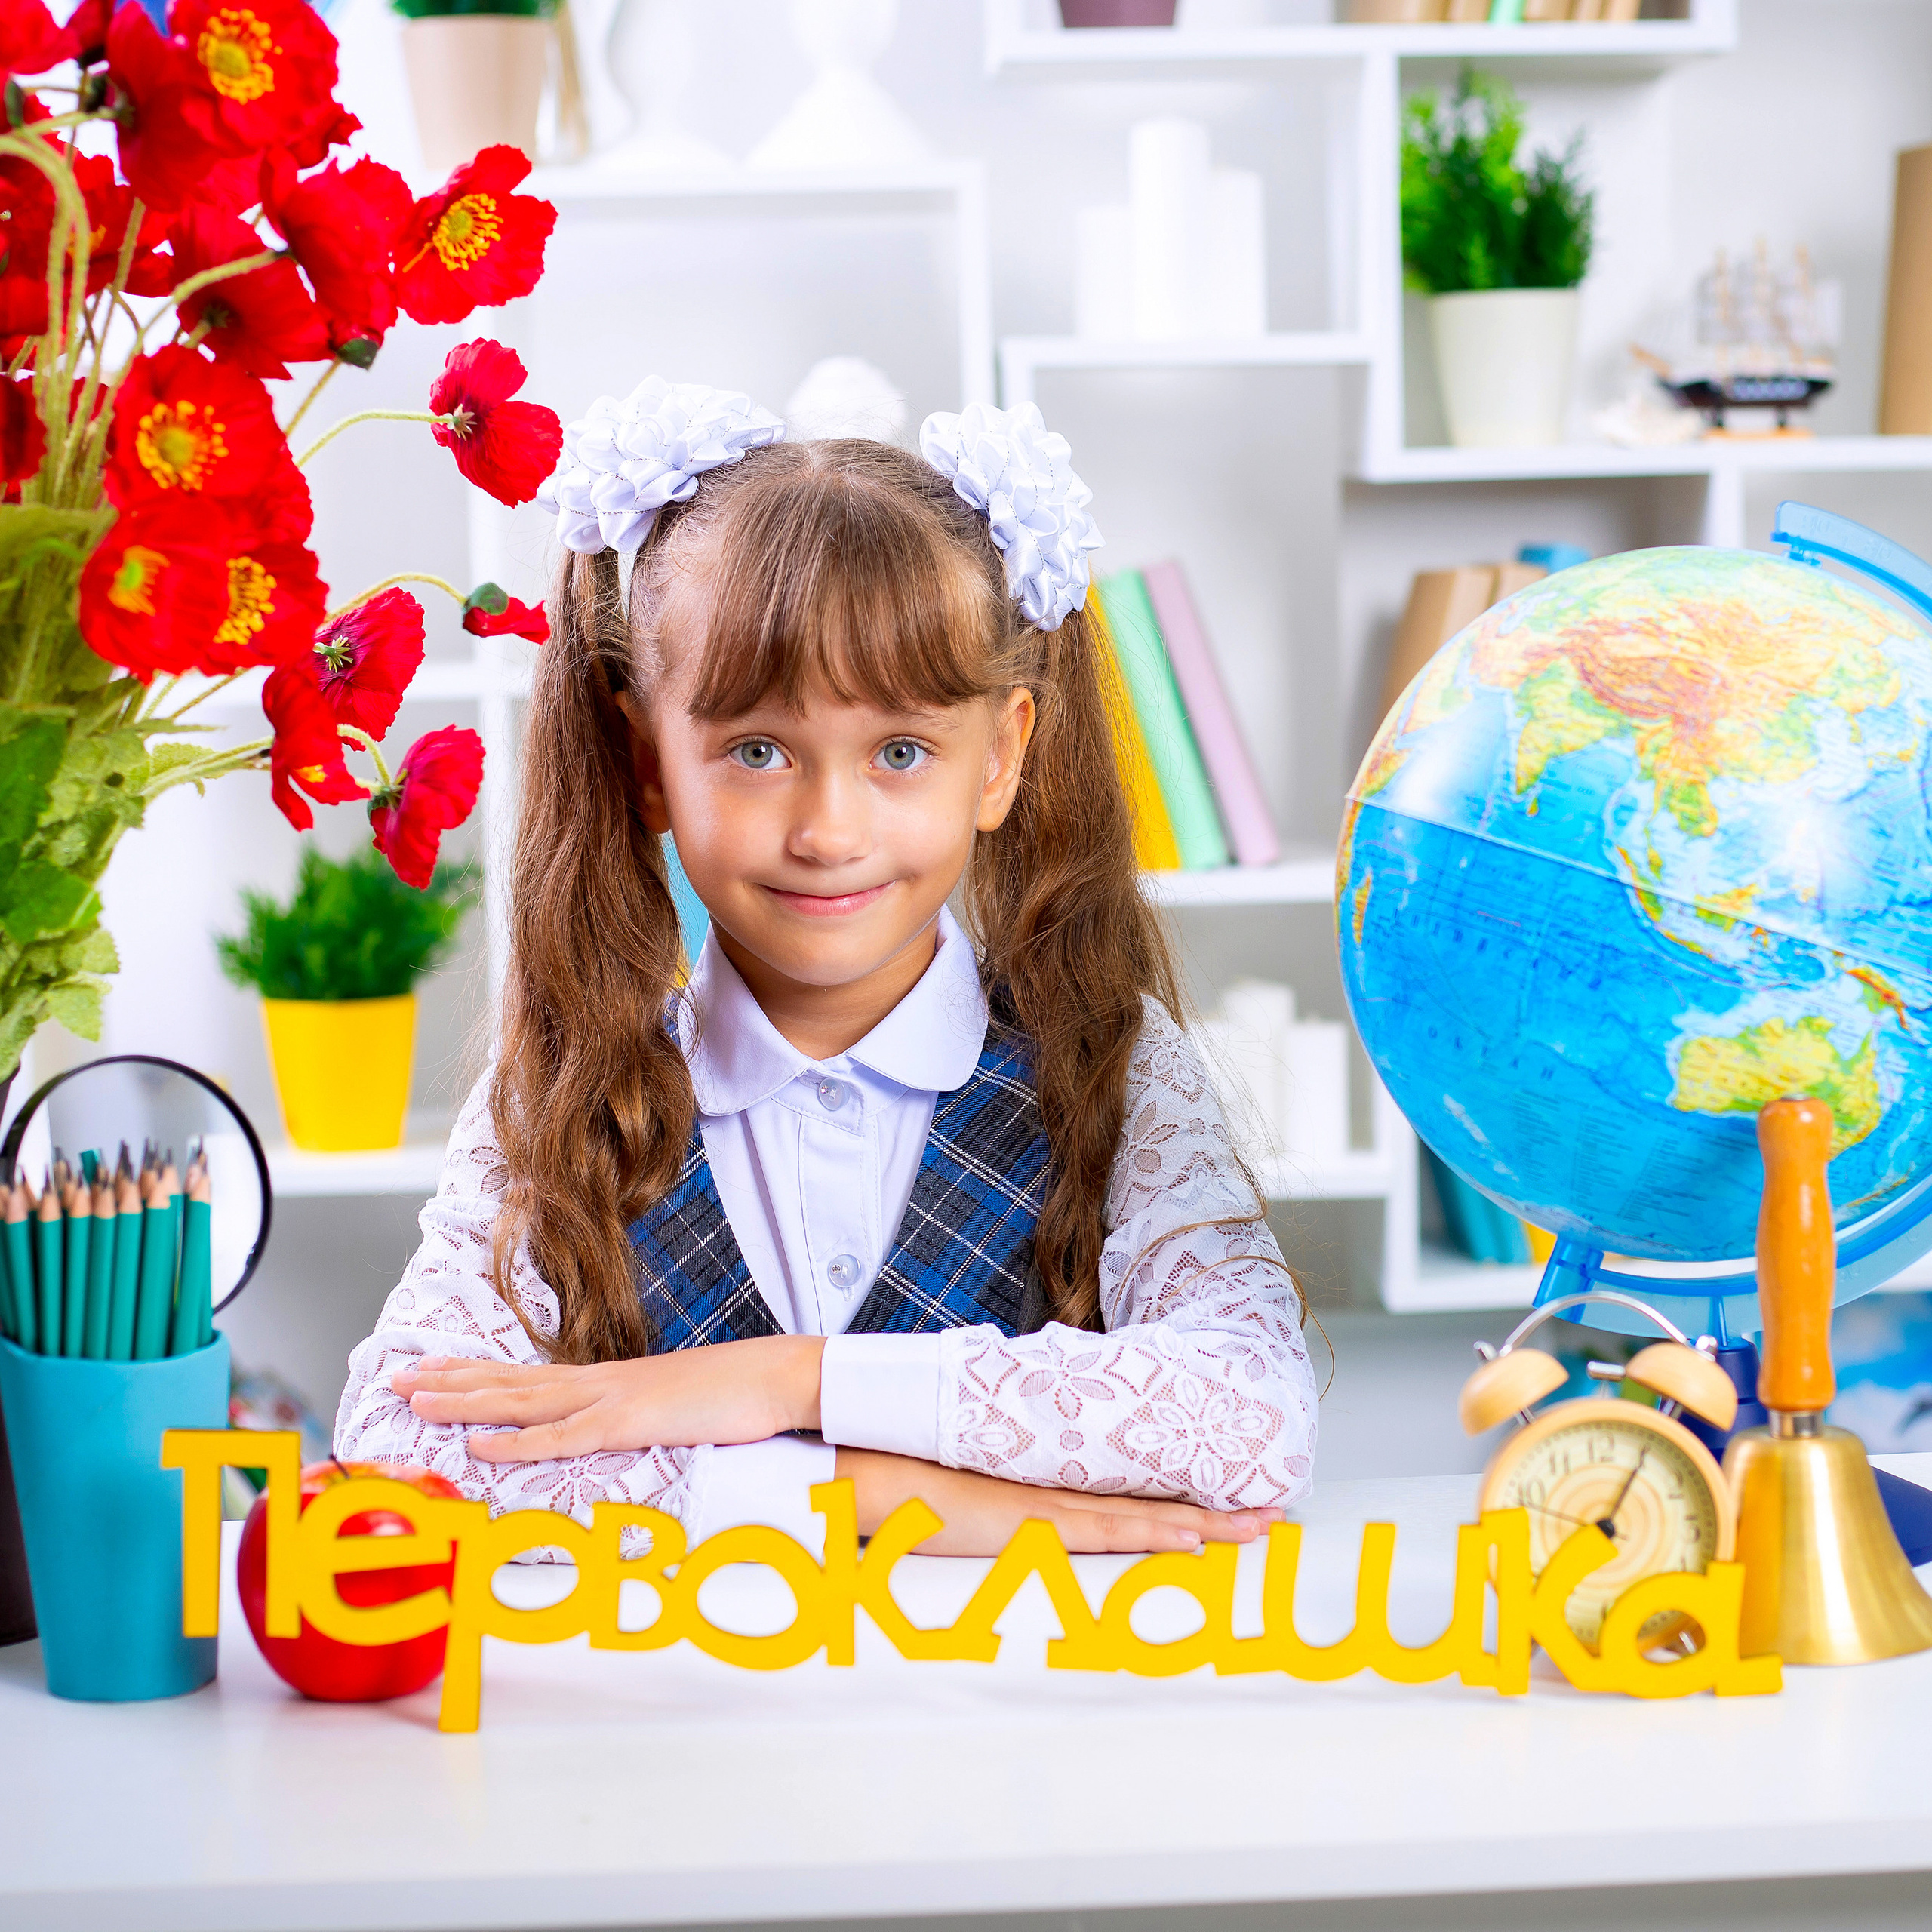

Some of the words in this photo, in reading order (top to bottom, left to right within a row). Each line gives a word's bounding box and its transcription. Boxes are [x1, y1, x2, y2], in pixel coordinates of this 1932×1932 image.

[1549, 1451, 1570, 1475] 11
[1587, 1432, 1615, 1463] 12
[1517, 1476, 1545, 1507] 10
[161, 1429, 1783, 1734] Первоклашка
